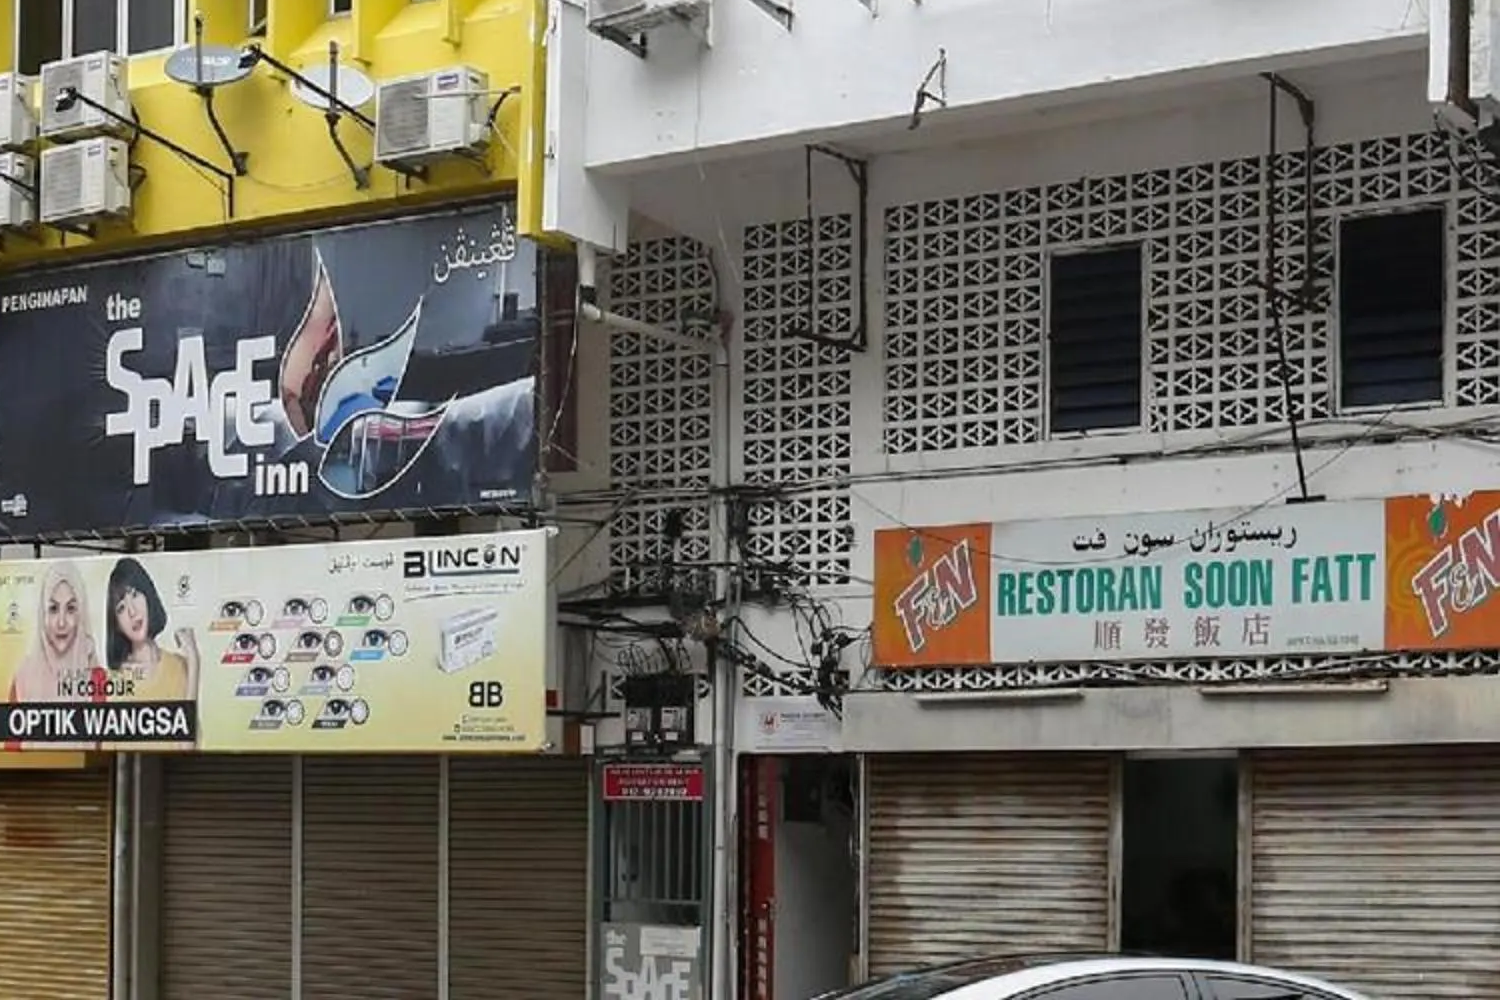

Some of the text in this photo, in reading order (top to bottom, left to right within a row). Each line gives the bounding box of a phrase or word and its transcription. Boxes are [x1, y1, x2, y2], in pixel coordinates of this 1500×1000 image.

[2, 285, 88, 313] PENGINAPAN
[106, 294, 141, 321] the
[254, 454, 309, 496] inn
[894, 538, 978, 654] F&N
[997, 553, 1376, 617] RESTORAN SOON FATT
[1094, 613, 1272, 650] 順發飯店
[57, 679, 136, 697] IN COLOUR
[8, 708, 78, 736] OPTIK
[84, 706, 190, 736] WANGSA
